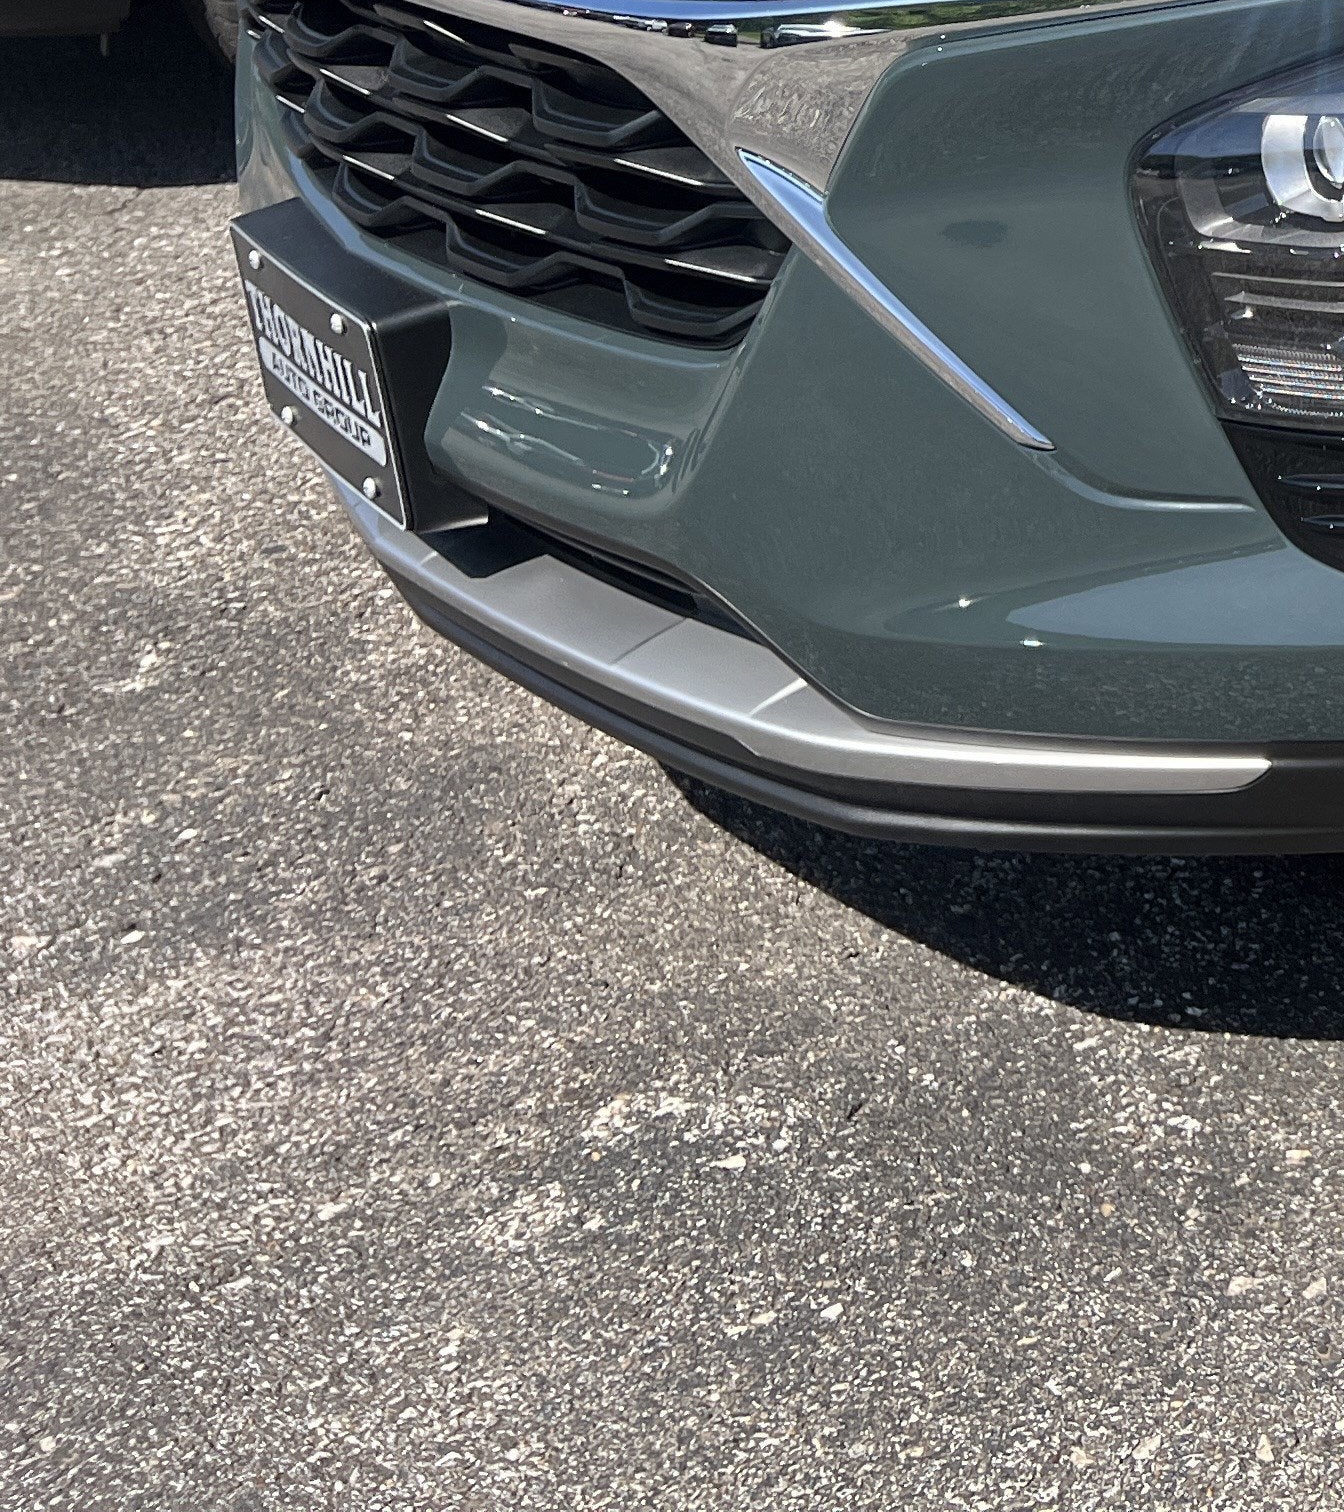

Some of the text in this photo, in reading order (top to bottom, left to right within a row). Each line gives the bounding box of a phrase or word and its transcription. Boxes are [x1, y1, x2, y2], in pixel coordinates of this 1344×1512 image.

[244, 279, 382, 428] THORNHILL
[271, 351, 372, 448] AUTO GROUP
